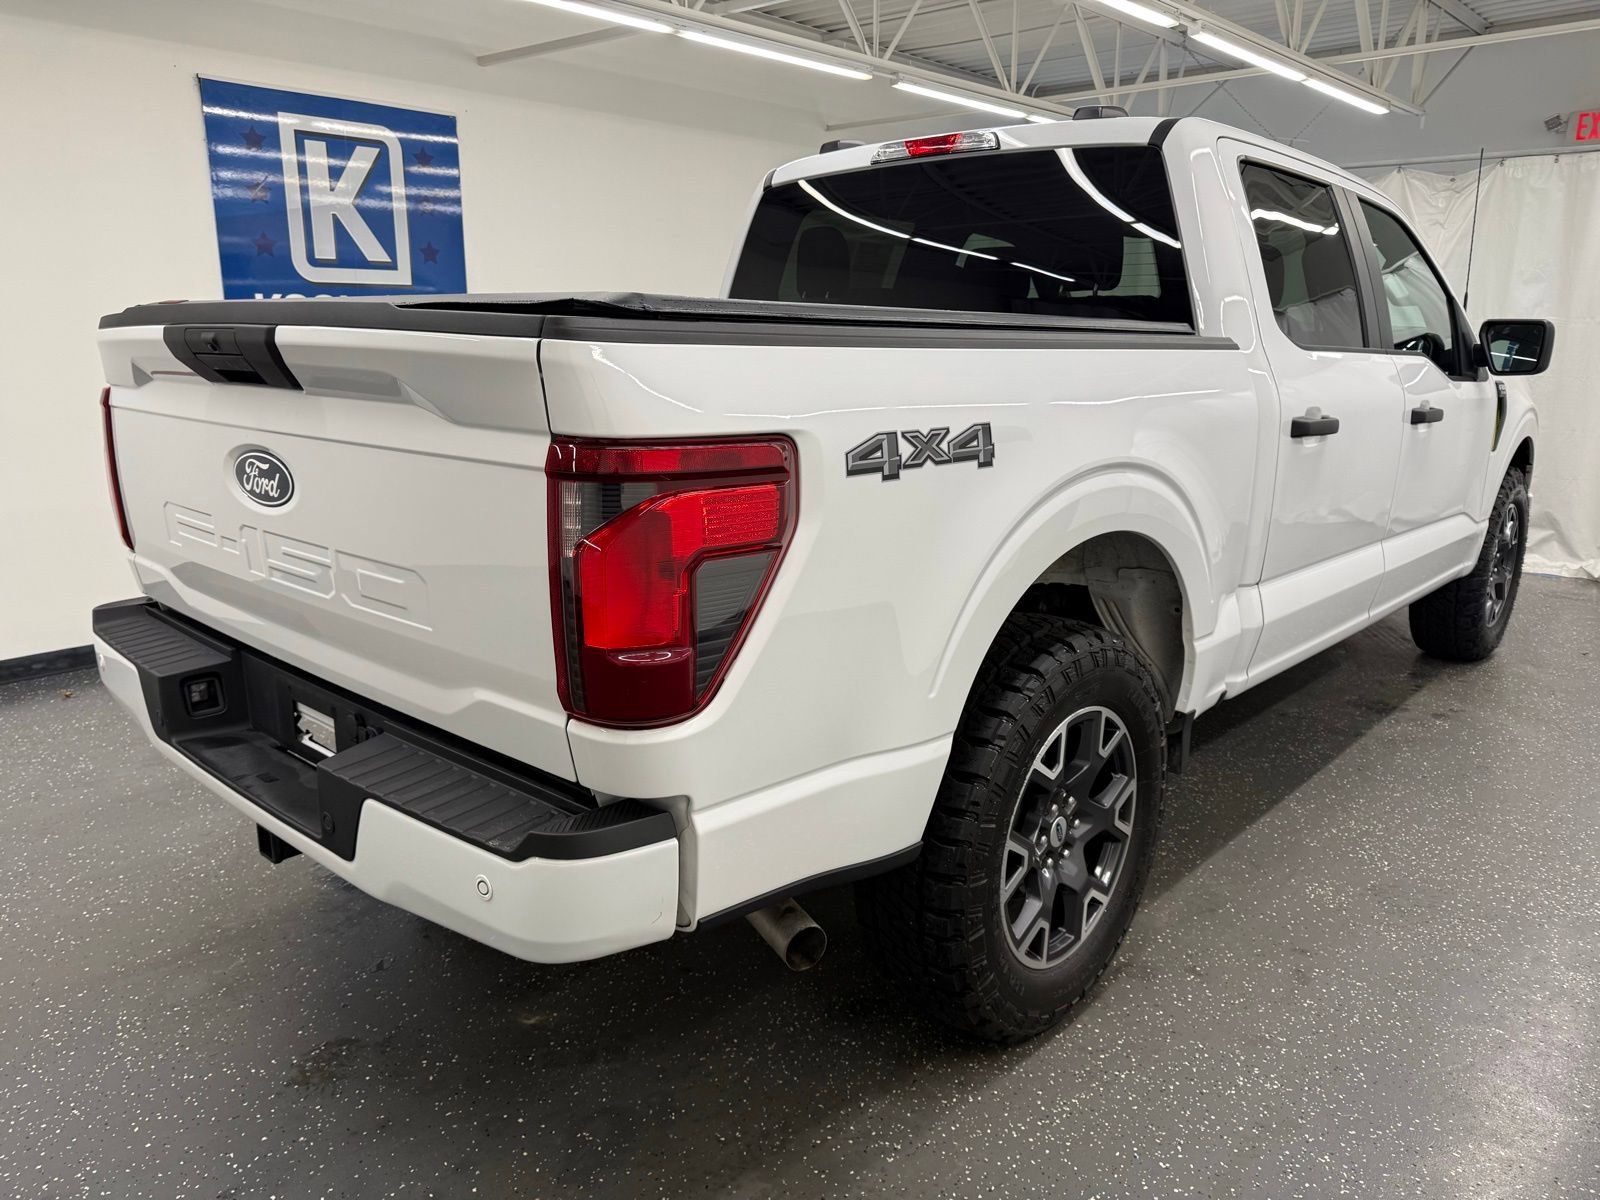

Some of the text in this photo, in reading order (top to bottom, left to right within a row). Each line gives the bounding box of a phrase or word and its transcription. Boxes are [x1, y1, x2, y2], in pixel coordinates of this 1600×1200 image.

[304, 139, 392, 263] K
[242, 457, 281, 499] Ford
[163, 500, 433, 632] F-150
